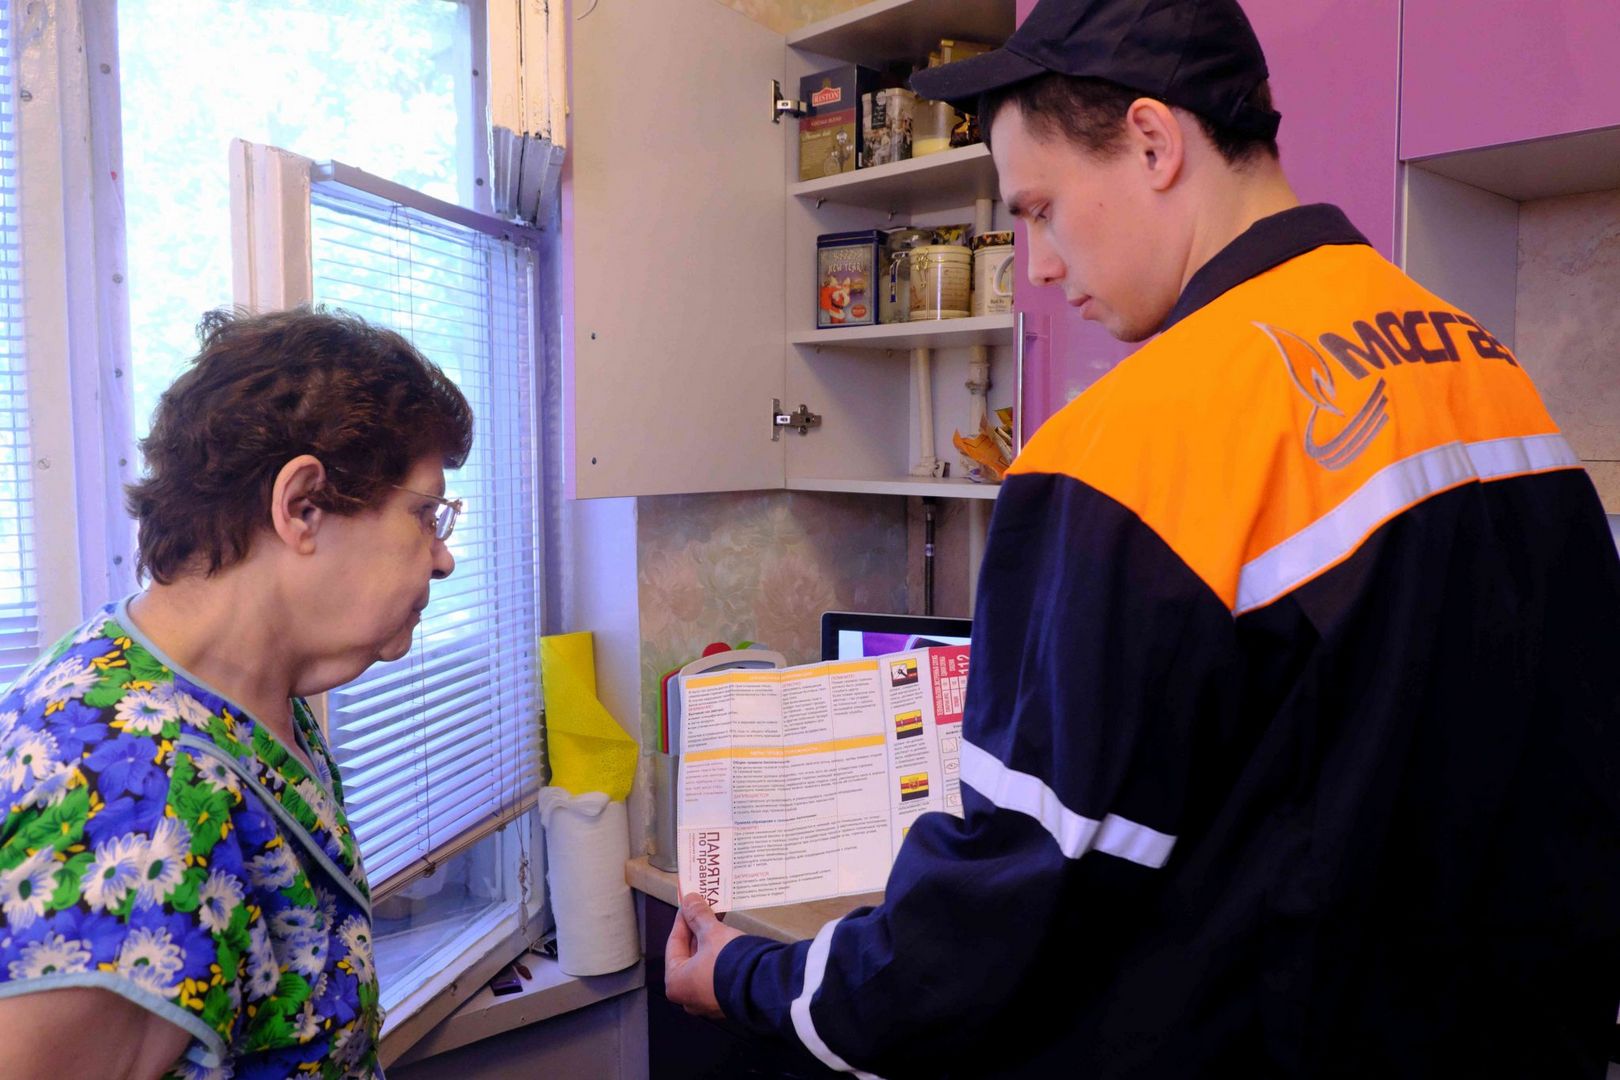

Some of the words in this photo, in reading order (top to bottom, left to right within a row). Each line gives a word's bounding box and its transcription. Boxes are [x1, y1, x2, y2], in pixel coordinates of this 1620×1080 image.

[814, 90, 839, 103] RISTON
[699, 833, 707, 846] по
[707, 832, 720, 907] ПАМЯТКА
